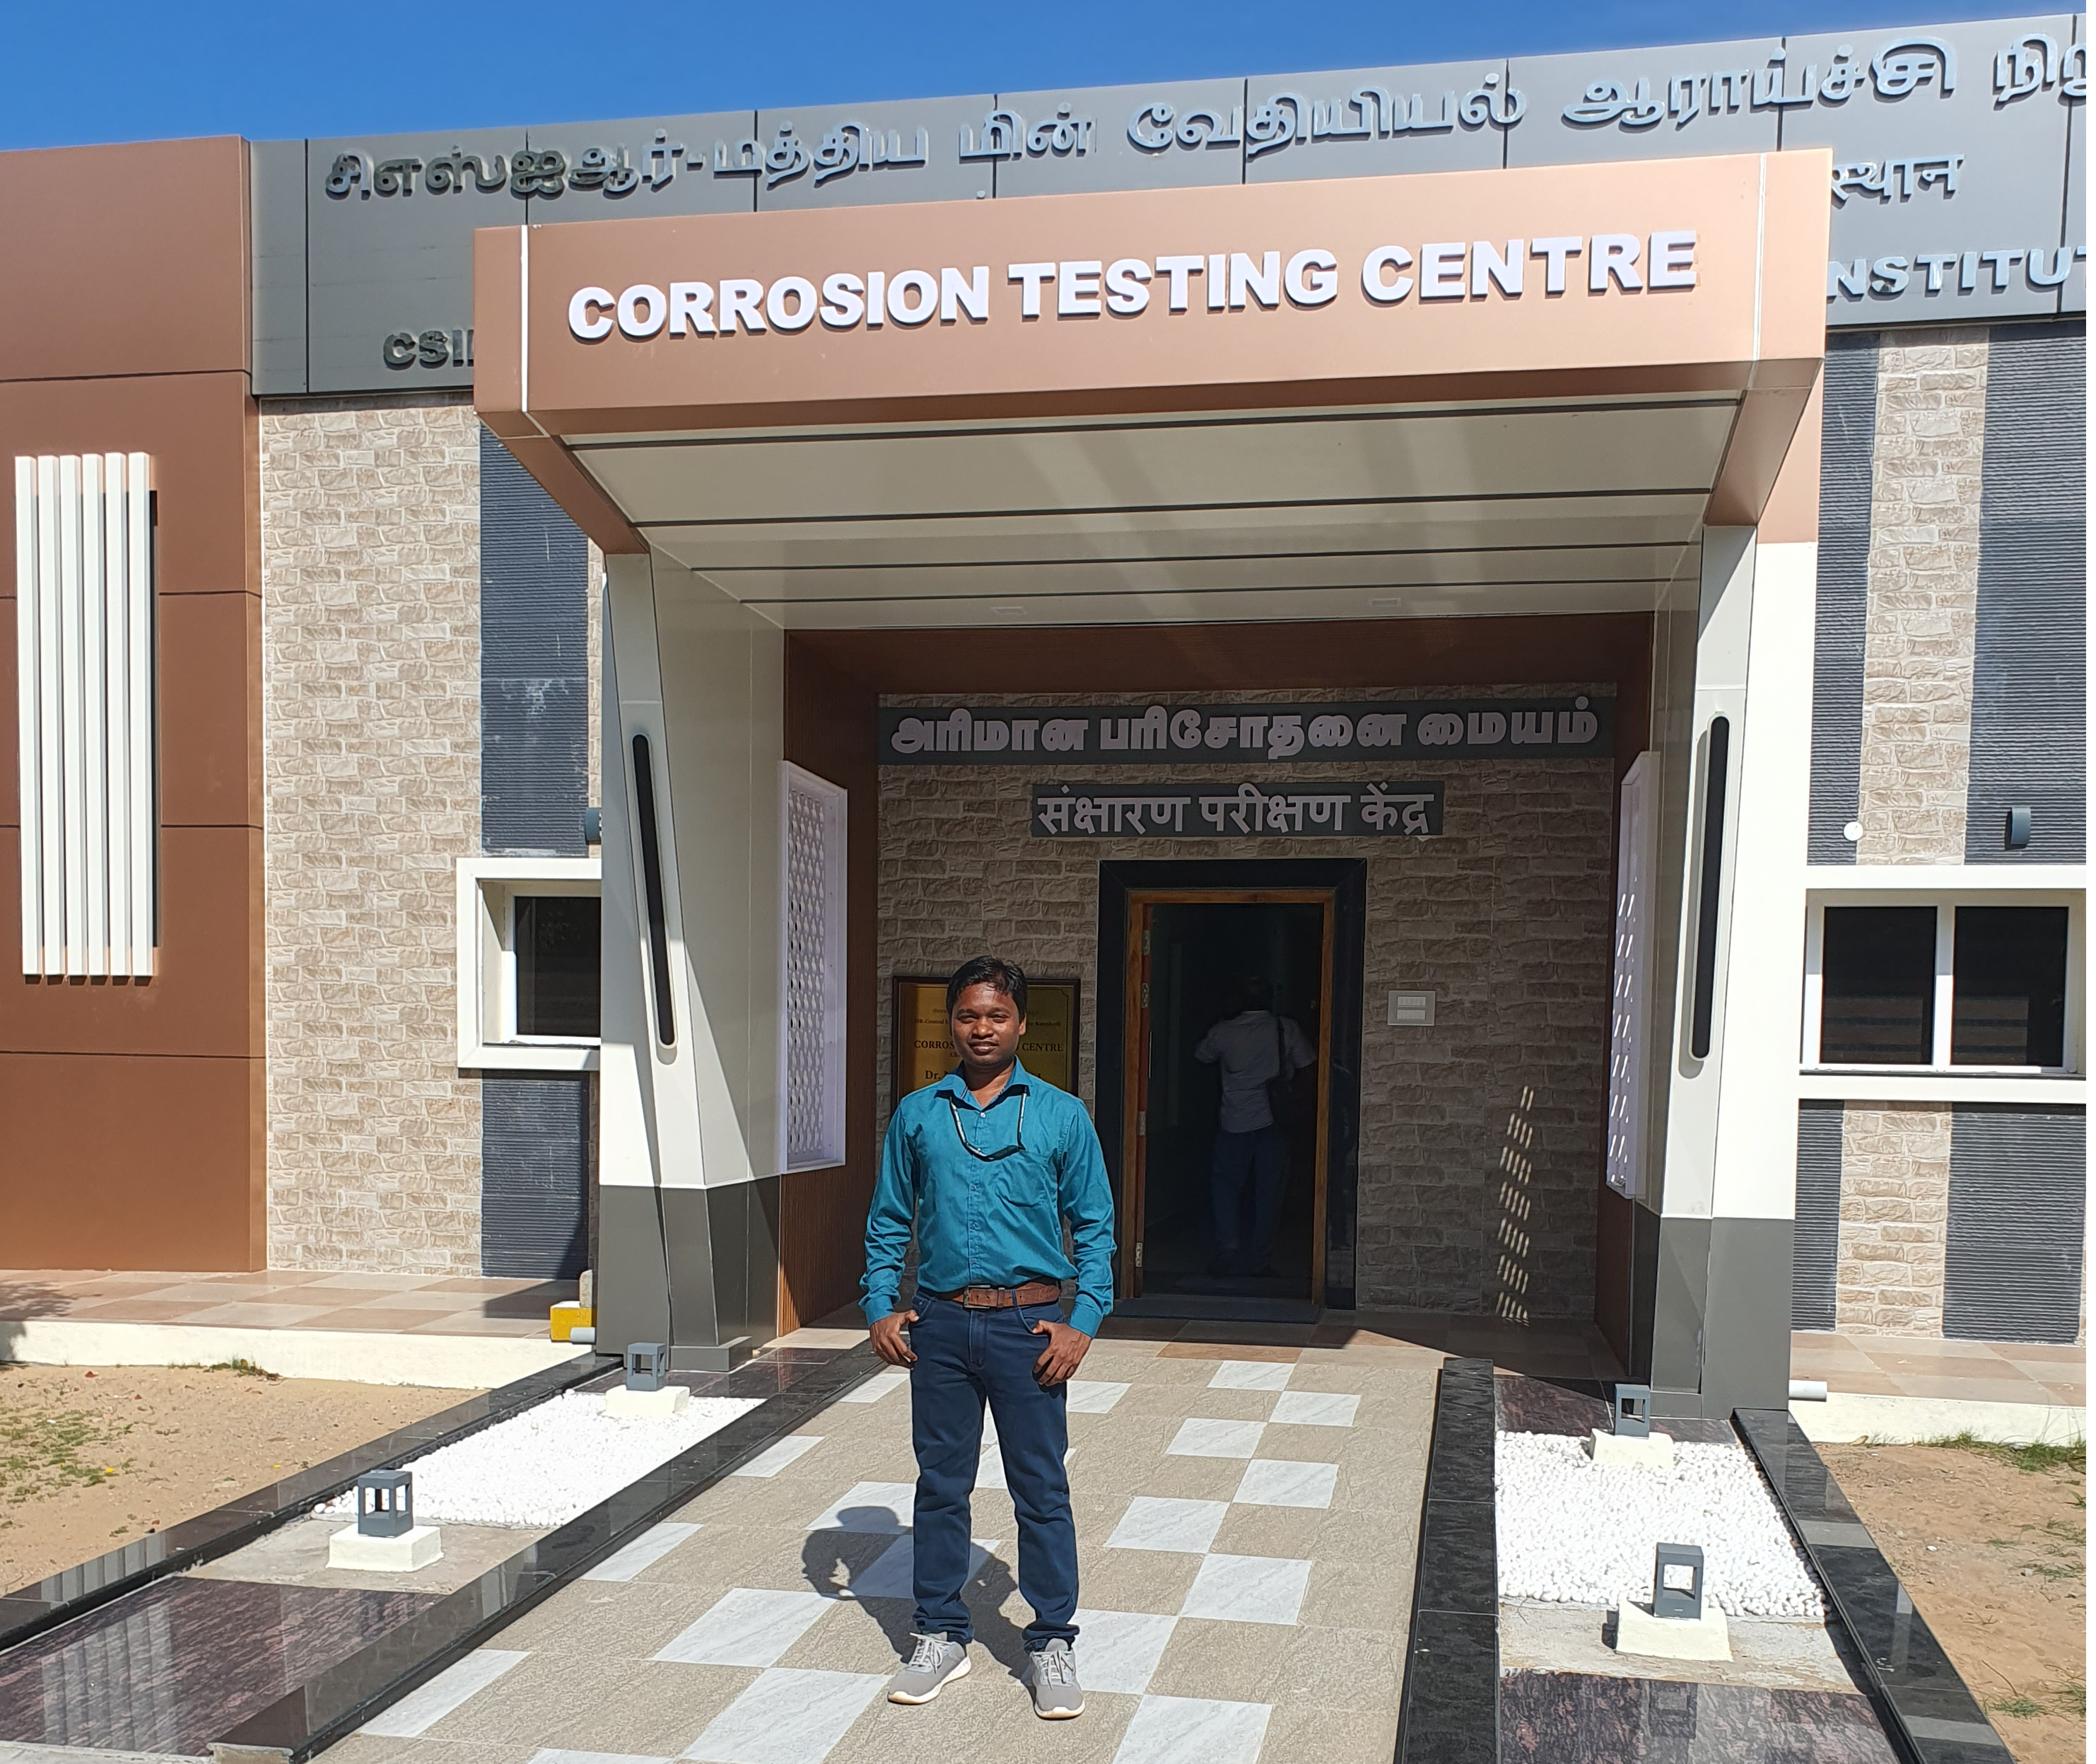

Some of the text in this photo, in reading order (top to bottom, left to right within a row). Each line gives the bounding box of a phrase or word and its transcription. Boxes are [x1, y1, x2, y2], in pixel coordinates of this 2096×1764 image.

[959, 102, 1093, 161] மின்
[1128, 73, 1528, 157] வேதியியல்
[1562, 36, 1957, 129] ஆராய்ச்சி
[1832, 154, 1965, 202] स्थान
[568, 230, 1698, 341] CORROSION TESTING CENTRE
[1827, 245, 2086, 297] NSTITU
[891, 696, 1598, 760] அரிமான பரிசோதனை மையம்
[1037, 781, 1435, 836] संक्षारण परीक्षण केंद्र
[914, 1040, 955, 1049] CORROS
[1021, 1043, 1064, 1052] CENTRE
